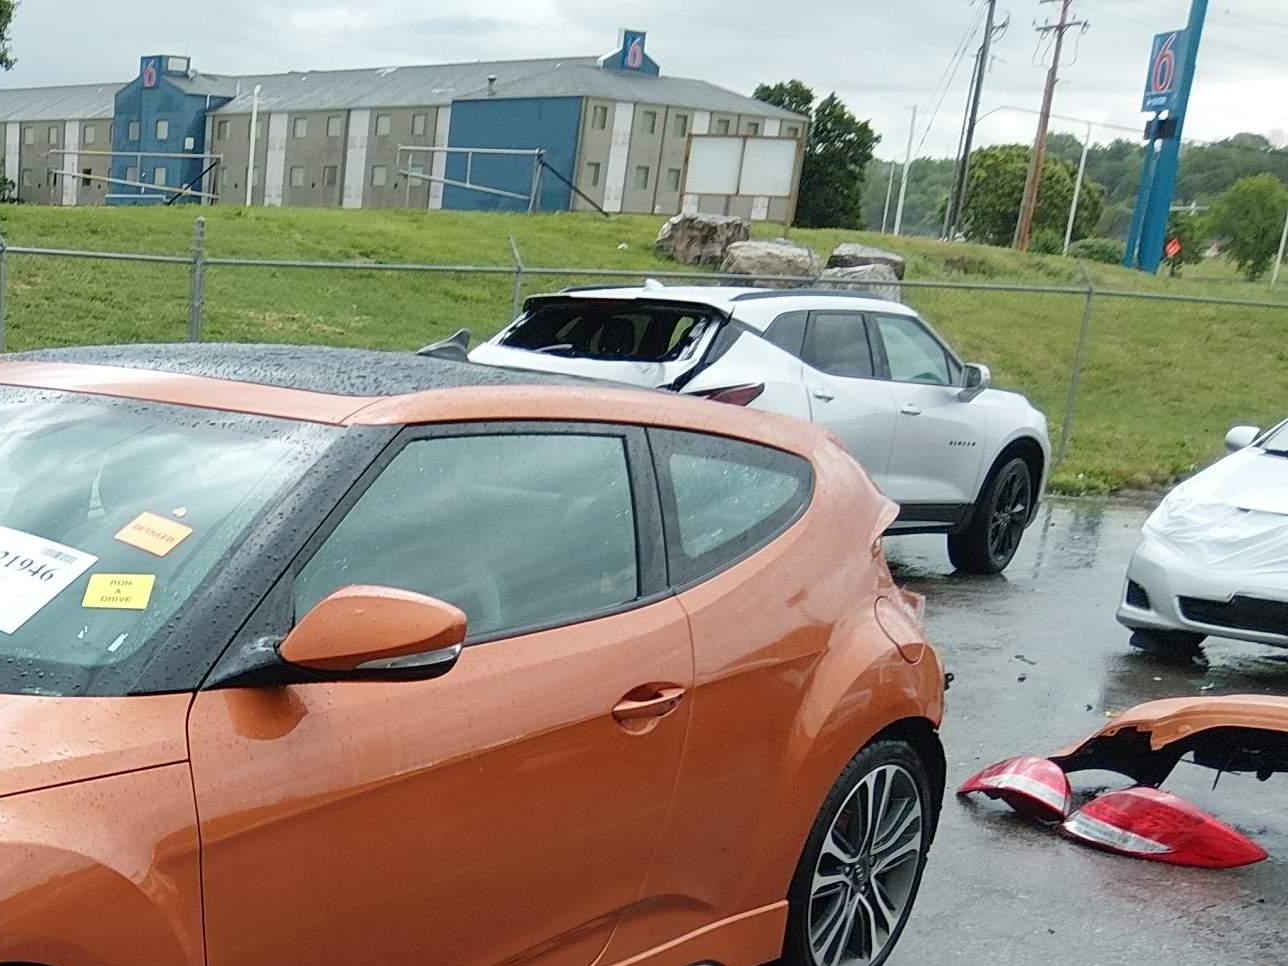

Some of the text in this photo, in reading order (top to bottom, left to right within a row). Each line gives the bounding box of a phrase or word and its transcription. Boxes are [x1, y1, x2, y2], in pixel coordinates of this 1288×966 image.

[628, 37, 642, 68] 6
[1154, 33, 1176, 92] 6
[143, 60, 156, 88] 6
[133, 525, 175, 543] DETAILED
[100, 595, 133, 604] DRIVE
